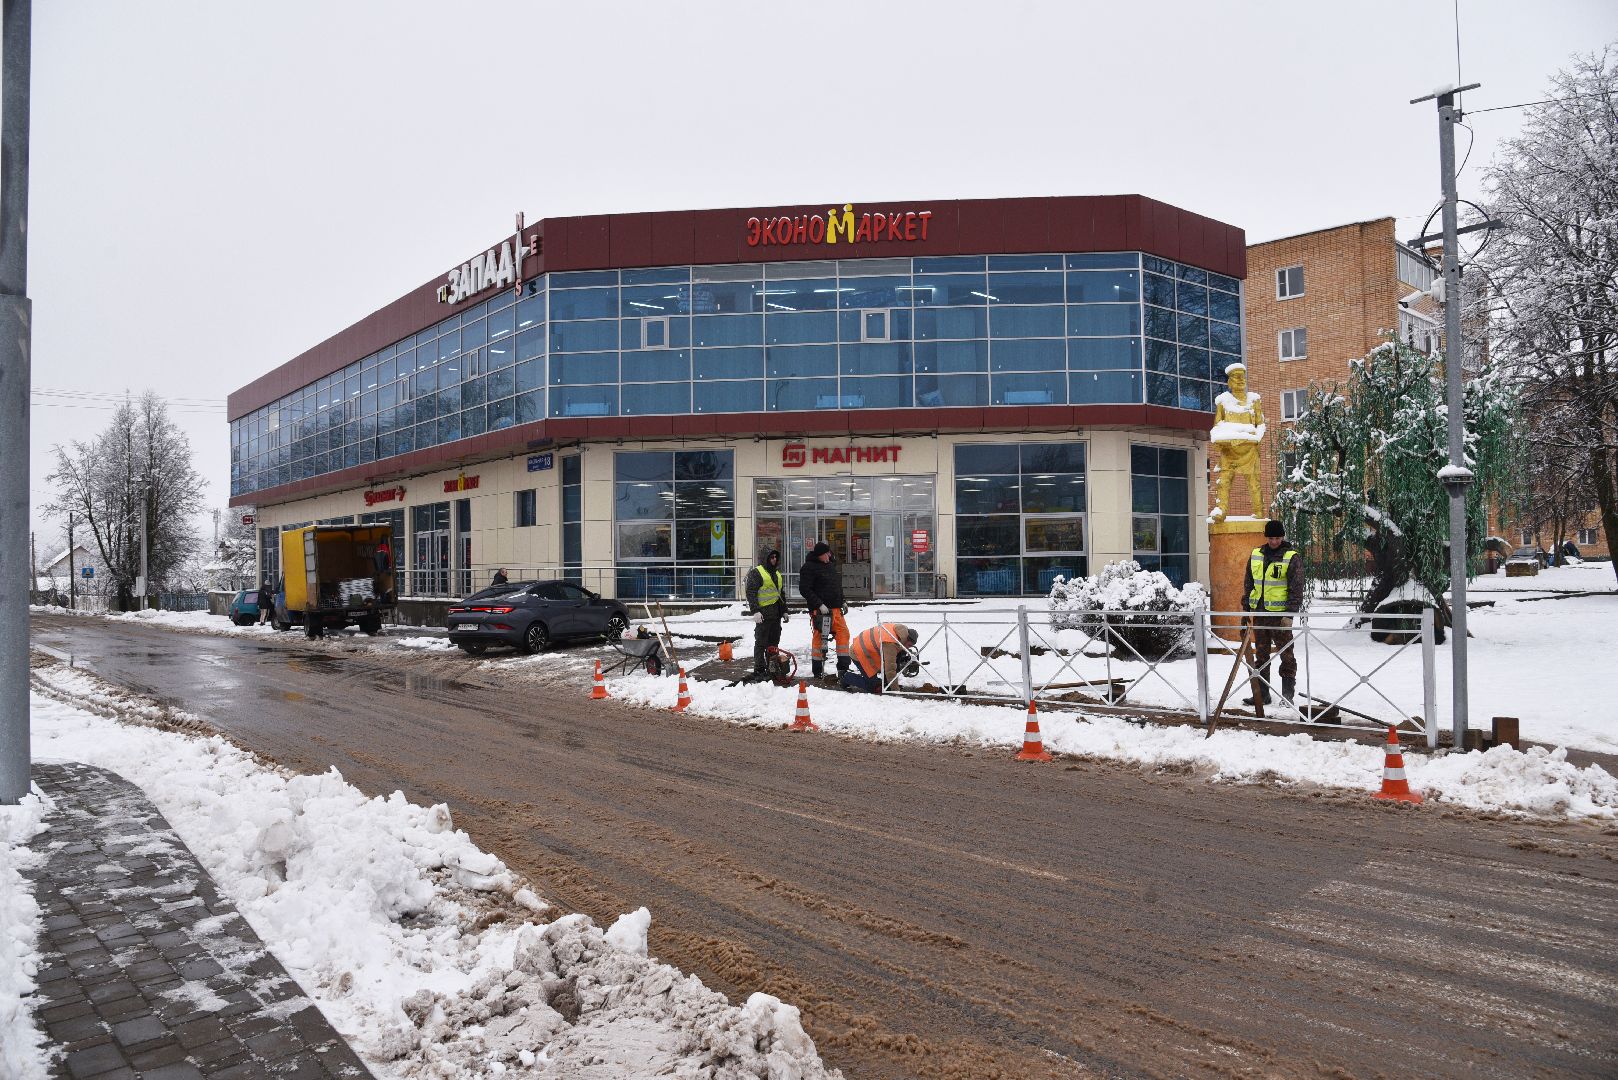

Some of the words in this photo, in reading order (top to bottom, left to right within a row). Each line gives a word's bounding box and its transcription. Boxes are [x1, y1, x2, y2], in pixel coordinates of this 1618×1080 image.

[747, 203, 932, 246] ЭКОНОМАРКЕТ
[448, 241, 515, 305] ЗАПАД
[544, 456, 551, 466] 18
[812, 446, 902, 464] МАГНИТ
